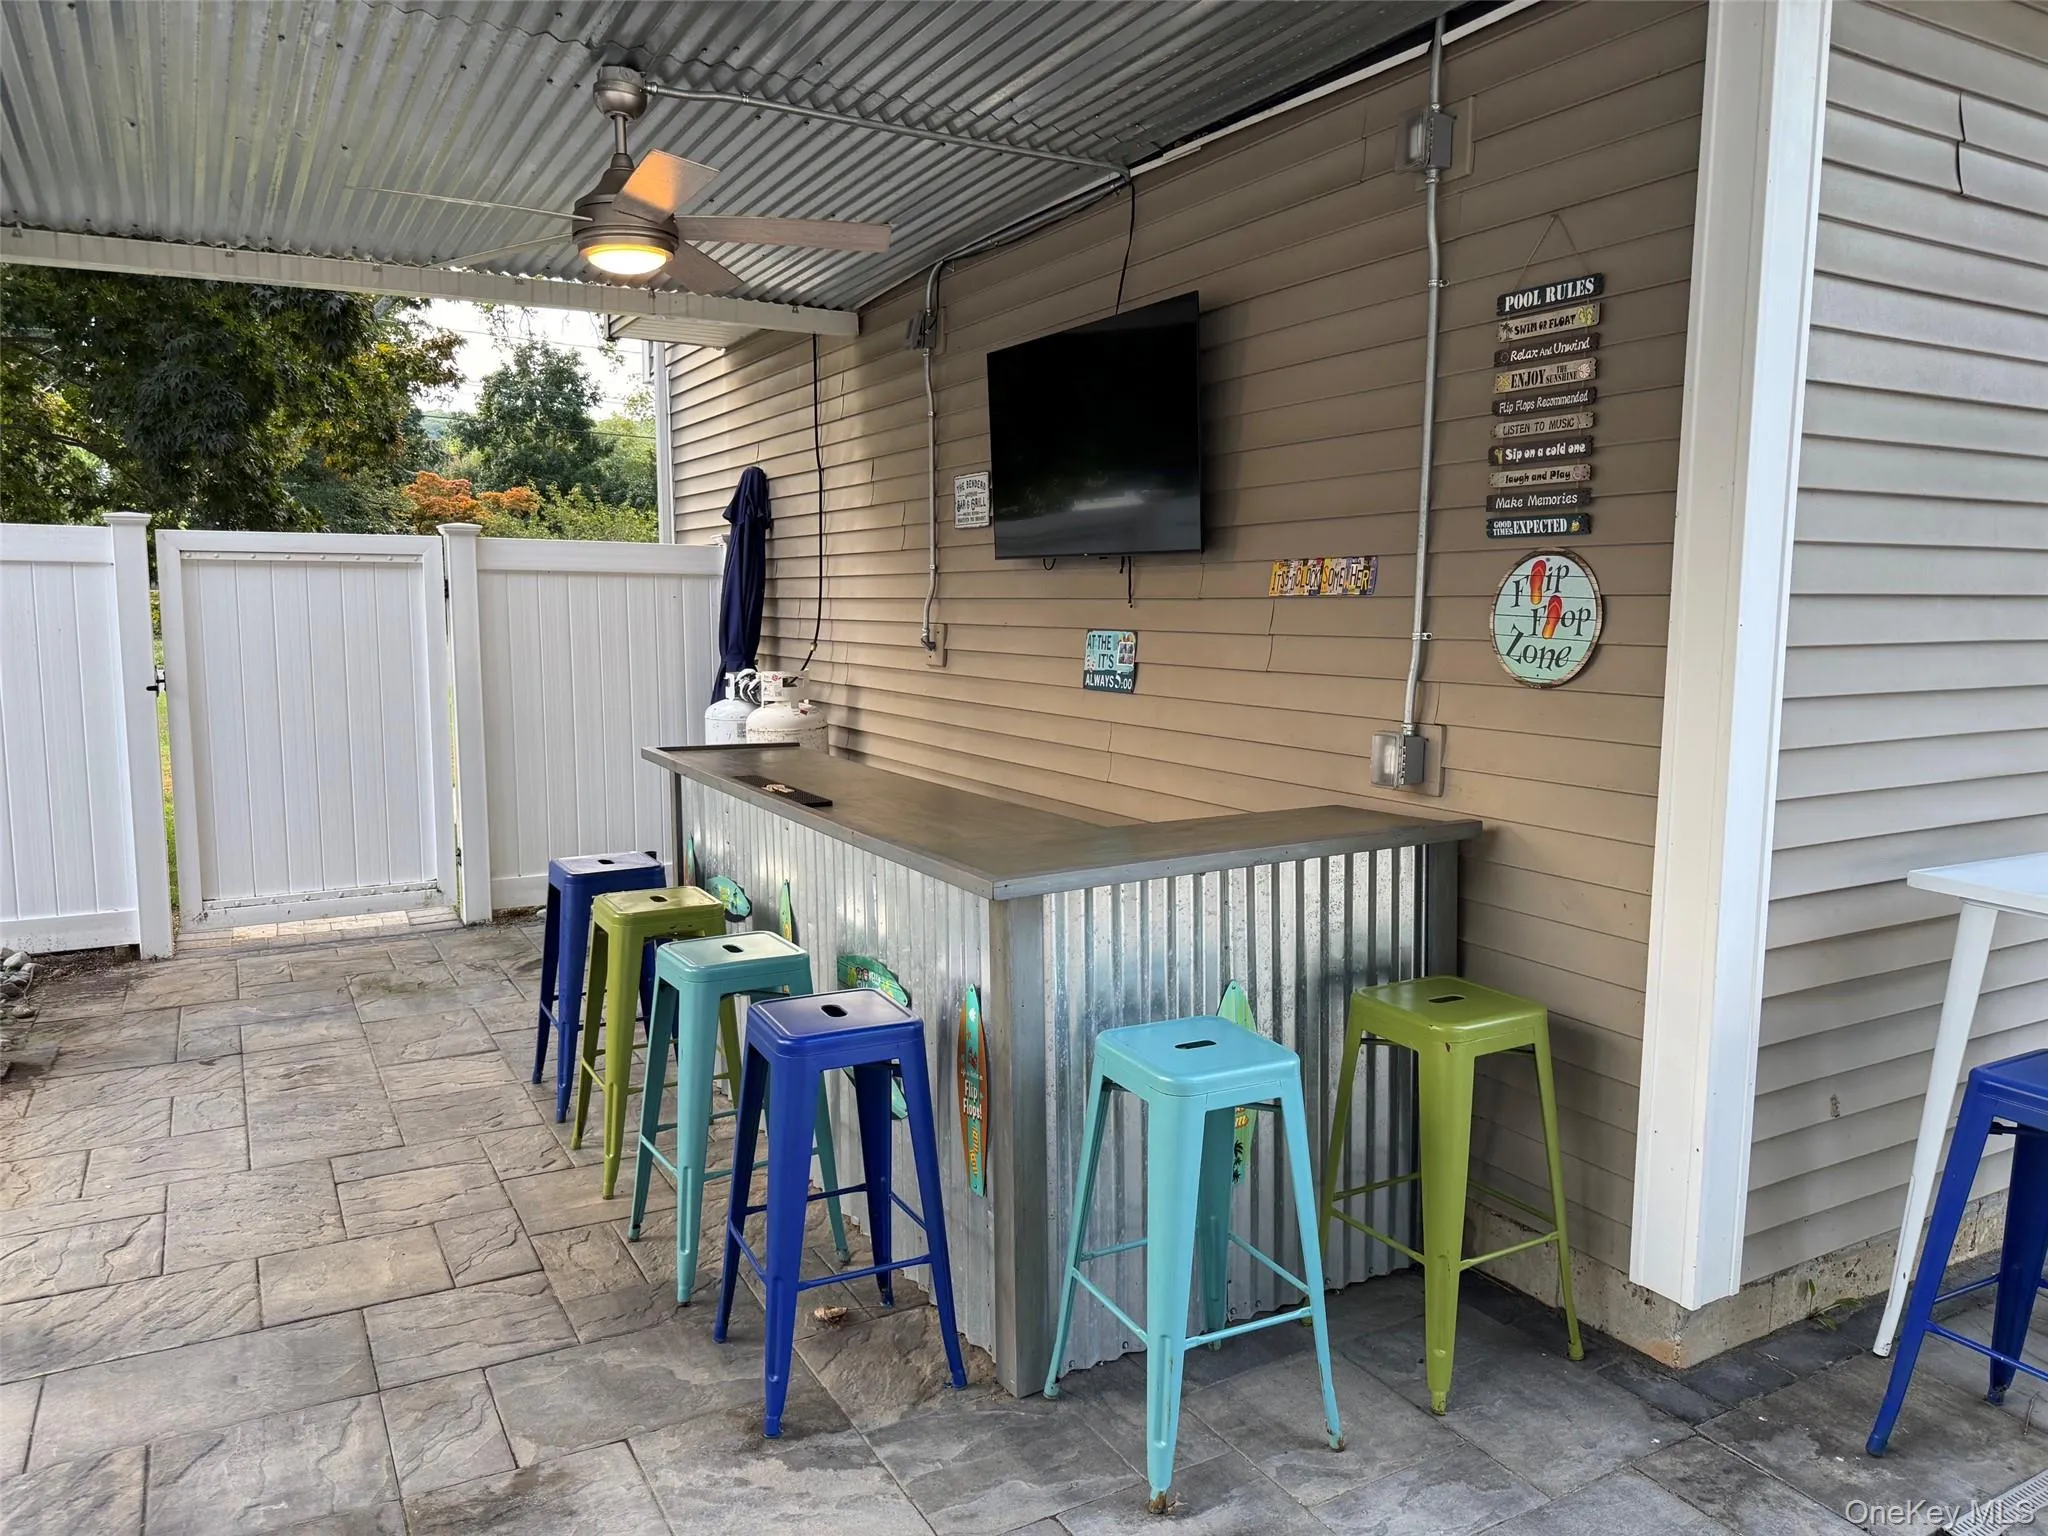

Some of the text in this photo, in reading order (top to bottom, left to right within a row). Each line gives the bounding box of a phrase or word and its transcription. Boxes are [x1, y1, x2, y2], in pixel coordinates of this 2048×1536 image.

[1504, 277, 1595, 312] POOL RULES
[1514, 314, 1576, 335] SWIM OR FLOAT
[1510, 348, 1538, 362] Relax
[1553, 336, 1590, 354] Unwind
[1511, 368, 1546, 389] ENJOY
[1546, 371, 1578, 384] SUNSHINE
[1499, 390, 1589, 414] Flip Flops Recommended
[1503, 418, 1575, 436] LISTEN TO MUSIC
[1505, 442, 1586, 462] Sip on a cold one
[1531, 471, 1547, 480] and
[1550, 470, 1571, 480] Play
[1495, 492, 1578, 509] Make Memories
[1493, 520, 1512, 529] GOOD
[1493, 528, 1514, 536] TIMES
[1513, 518, 1568, 535] EXPECTED
[1087, 634, 1112, 650] AT THE
[1505, 623, 1572, 672] Zone
[1098, 653, 1114, 669] IT'S
[1085, 673, 1114, 688] ALWAYS
[965, 1080, 978, 1102] Flip
[963, 1098, 983, 1120] Flops!
